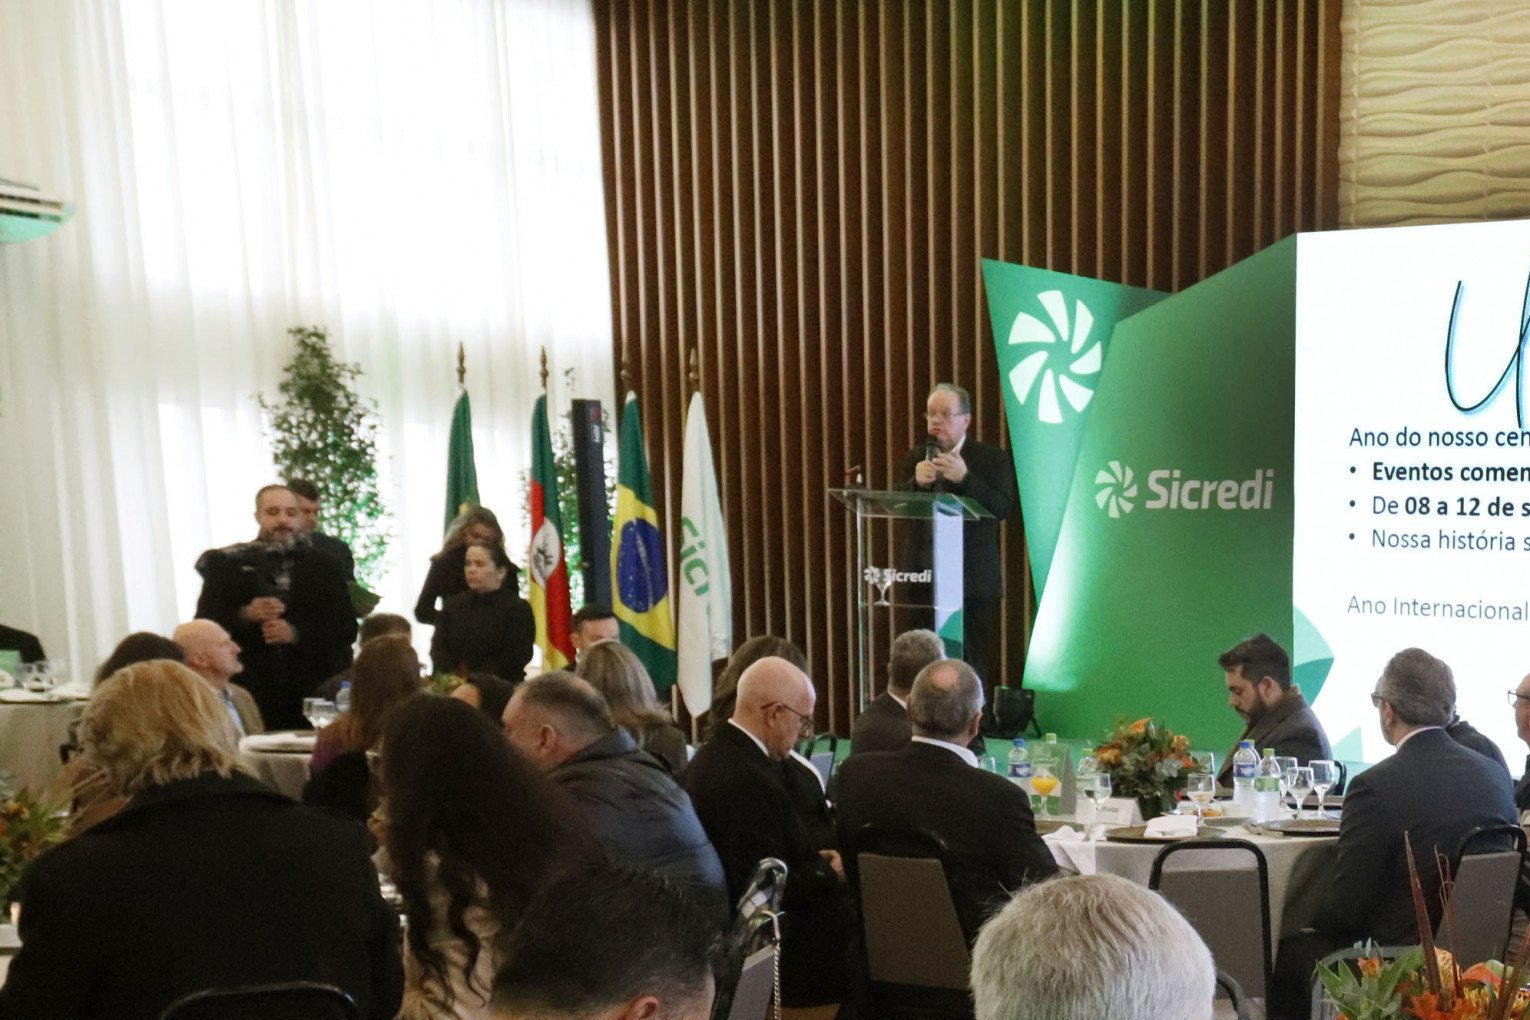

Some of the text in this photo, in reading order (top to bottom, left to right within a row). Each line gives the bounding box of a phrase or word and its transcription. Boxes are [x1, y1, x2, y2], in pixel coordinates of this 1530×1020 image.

[1349, 427, 1390, 447] Ano
[1395, 425, 1422, 447] do
[1428, 430, 1489, 447] nosso
[1372, 461, 1454, 482] Eventos
[1145, 468, 1275, 511] Sicredi
[1372, 495, 1399, 515] De
[1404, 496, 1431, 516] 08
[1436, 500, 1449, 516] a
[1456, 496, 1481, 517] 12
[1487, 495, 1515, 517] de
[1372, 528, 1431, 549] Nossa
[1438, 529, 1516, 551] história
[883, 568, 932, 583] Sicredi
[1346, 595, 1387, 615] Ano
[1393, 597, 1529, 621] Internacional
